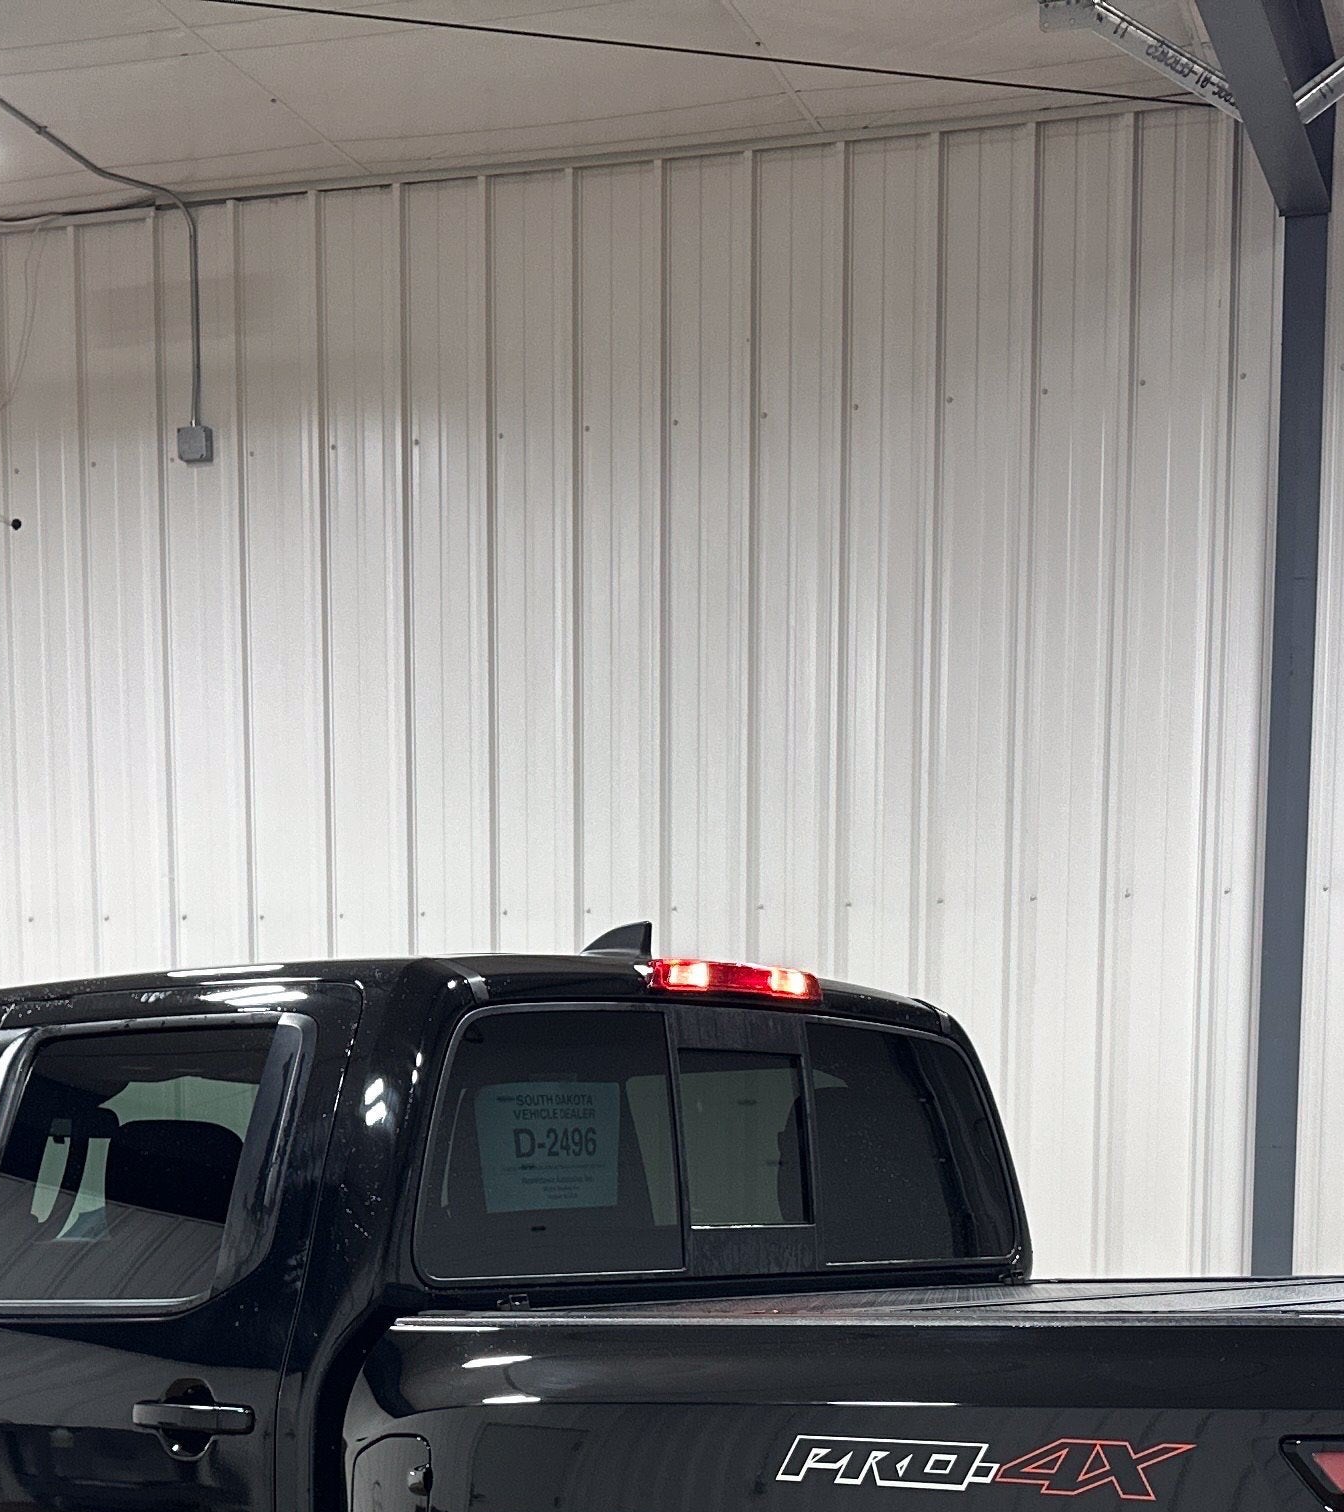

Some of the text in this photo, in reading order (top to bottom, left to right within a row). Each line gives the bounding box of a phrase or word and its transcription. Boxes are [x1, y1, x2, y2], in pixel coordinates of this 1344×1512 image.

[515, 1095, 553, 1106] SOUTH
[555, 1094, 593, 1106] DAKOTA
[513, 1108, 596, 1121] VEHICLE DEALER
[513, 1127, 597, 1159] D-2496
